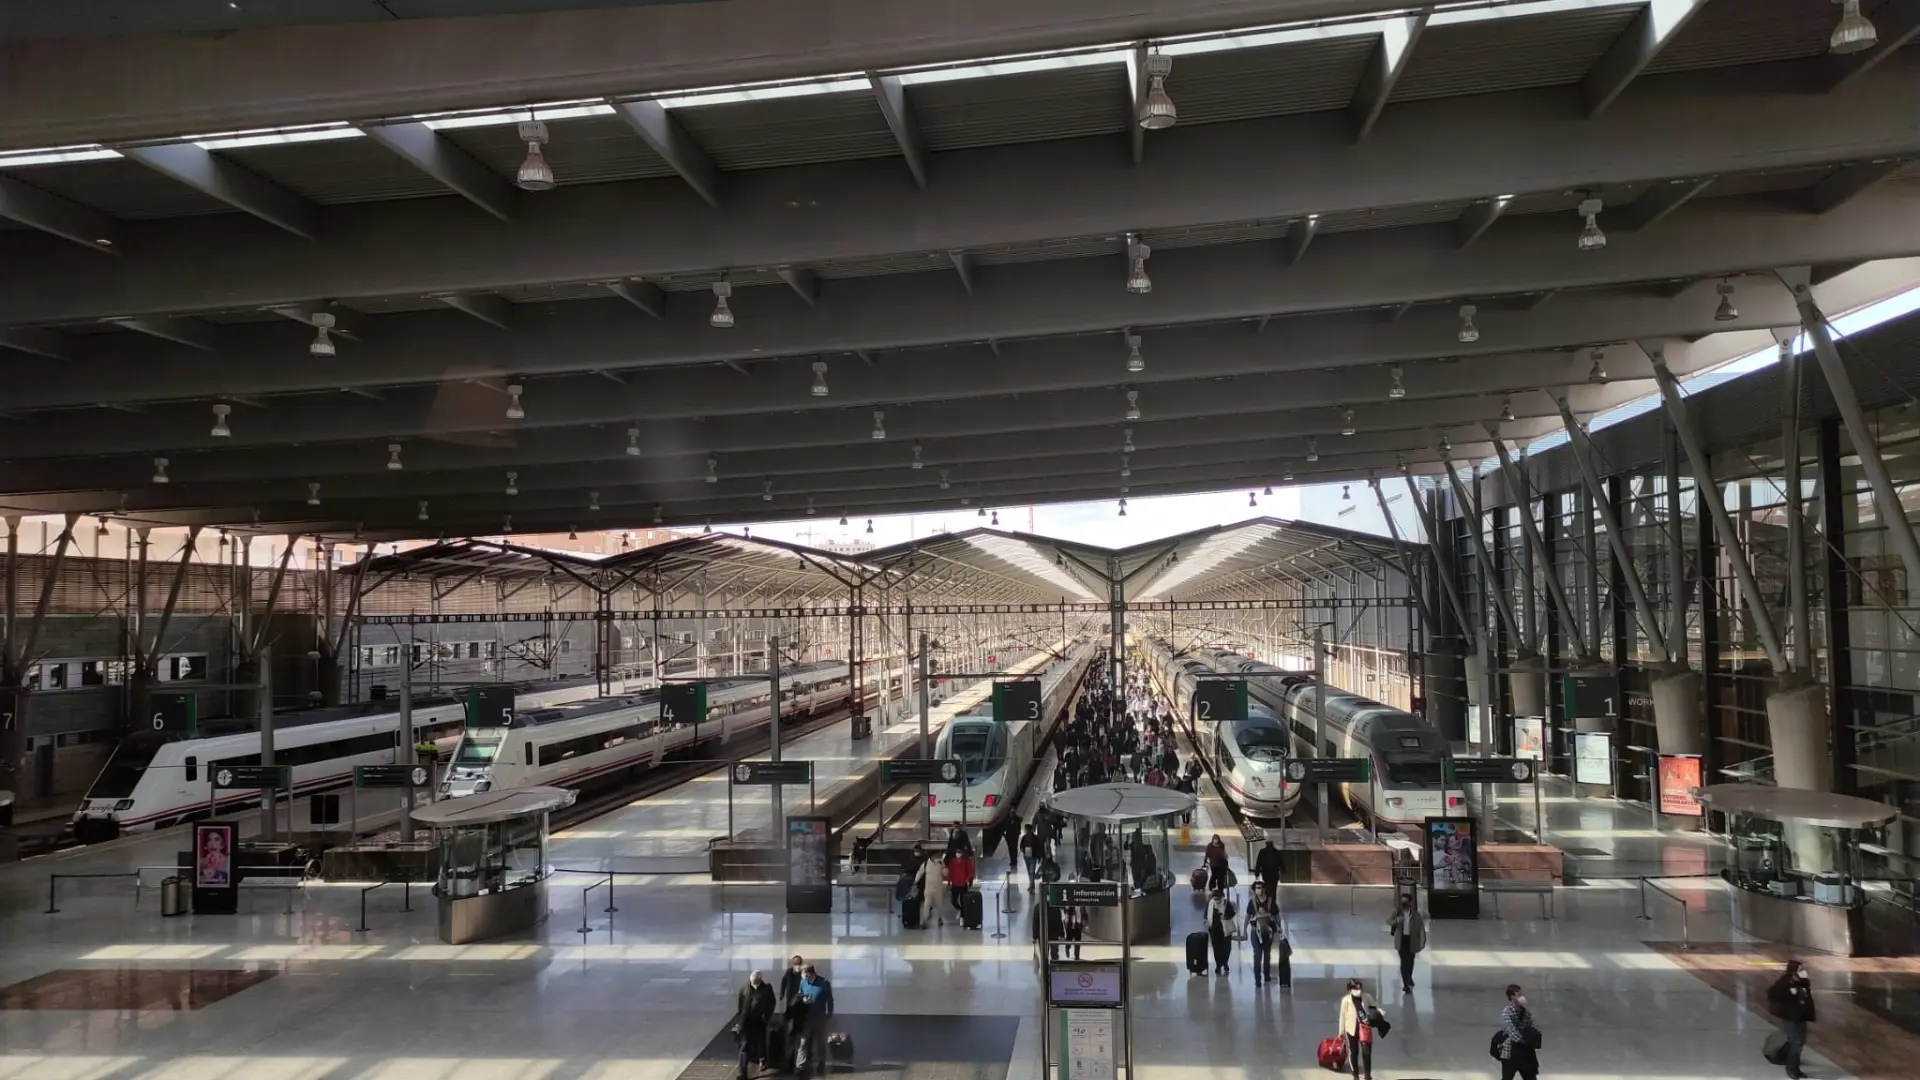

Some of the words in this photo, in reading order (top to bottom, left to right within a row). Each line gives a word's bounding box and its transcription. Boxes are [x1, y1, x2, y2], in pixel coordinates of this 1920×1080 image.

[662, 704, 674, 721] 4
[1028, 700, 1039, 719] 3
[1200, 701, 1211, 719] 2
[1604, 698, 1617, 716] 1
[3, 713, 12, 730] 7
[153, 712, 164, 730] 6
[502, 708, 512, 725] 5
[1073, 889, 1115, 897] Información
